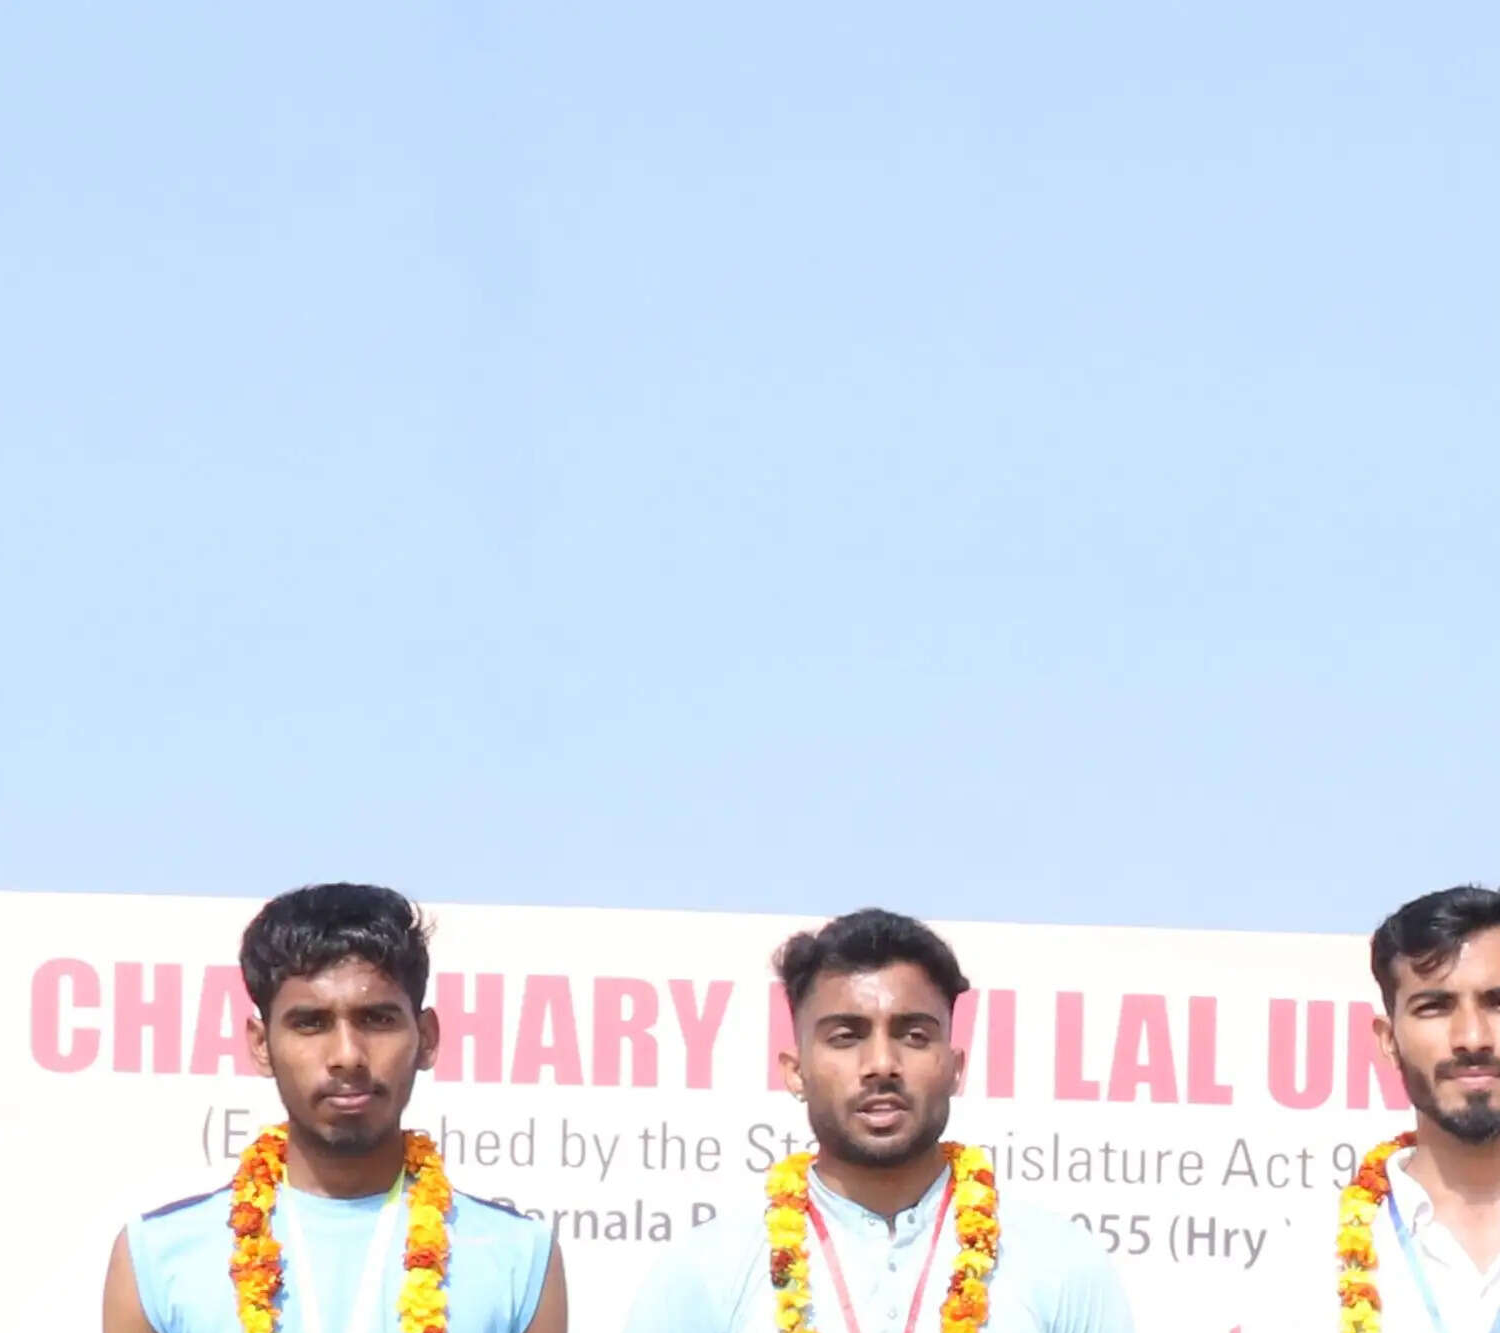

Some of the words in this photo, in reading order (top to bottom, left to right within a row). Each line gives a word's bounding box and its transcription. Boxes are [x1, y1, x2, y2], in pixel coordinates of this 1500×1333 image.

[30, 957, 734, 1091] CHAHARY
[1053, 990, 1234, 1106] LAL
[561, 1117, 620, 1182] by
[638, 1120, 722, 1173] the
[980, 1131, 1204, 1189] islature
[1221, 1137, 1315, 1189] Act
